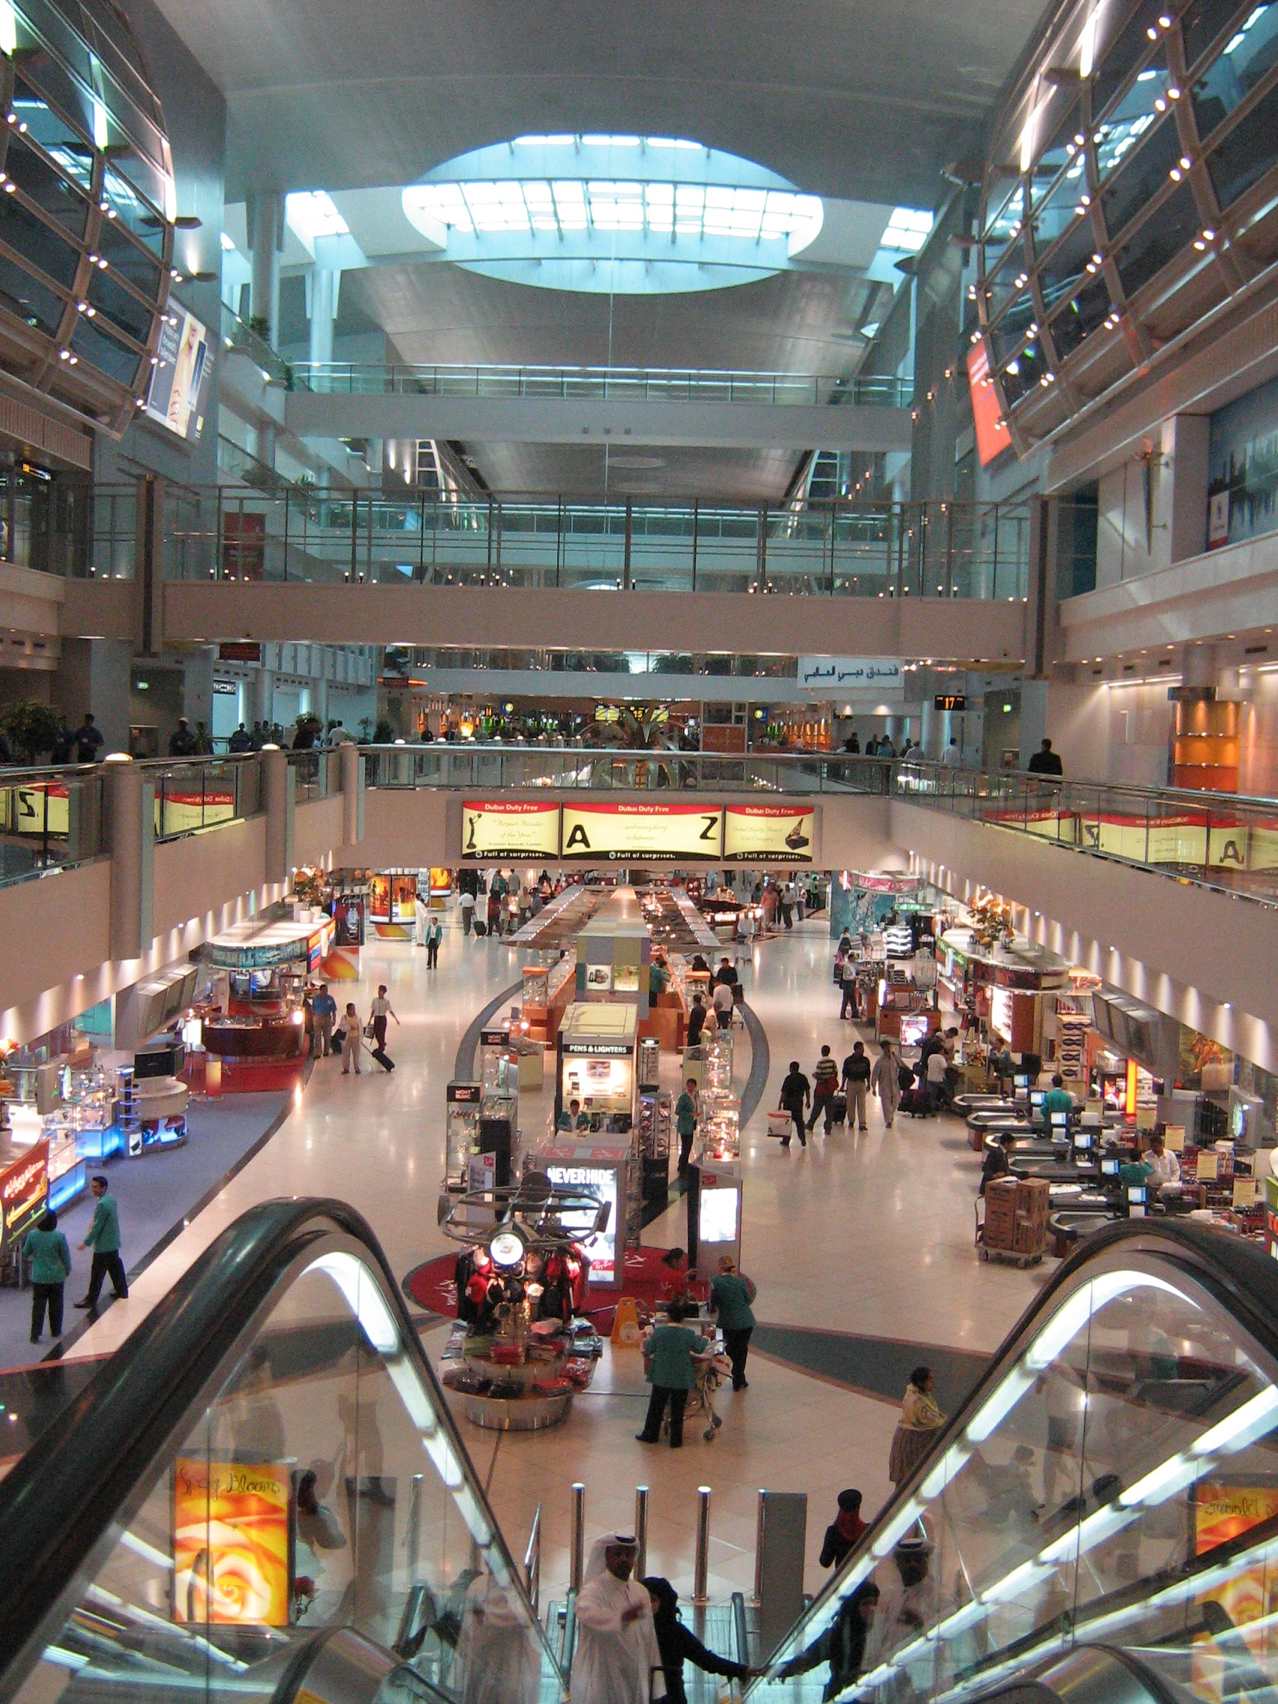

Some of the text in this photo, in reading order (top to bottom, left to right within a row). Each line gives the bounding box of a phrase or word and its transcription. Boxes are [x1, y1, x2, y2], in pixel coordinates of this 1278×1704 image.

[944, 697, 955, 709] 17
[506, 803, 522, 812] Duty
[639, 805, 654, 813] Duty
[765, 807, 779, 815] Duty
[699, 815, 719, 840] Z
[566, 824, 591, 849] A
[546, 1167, 614, 1184] NEVER HIDE
